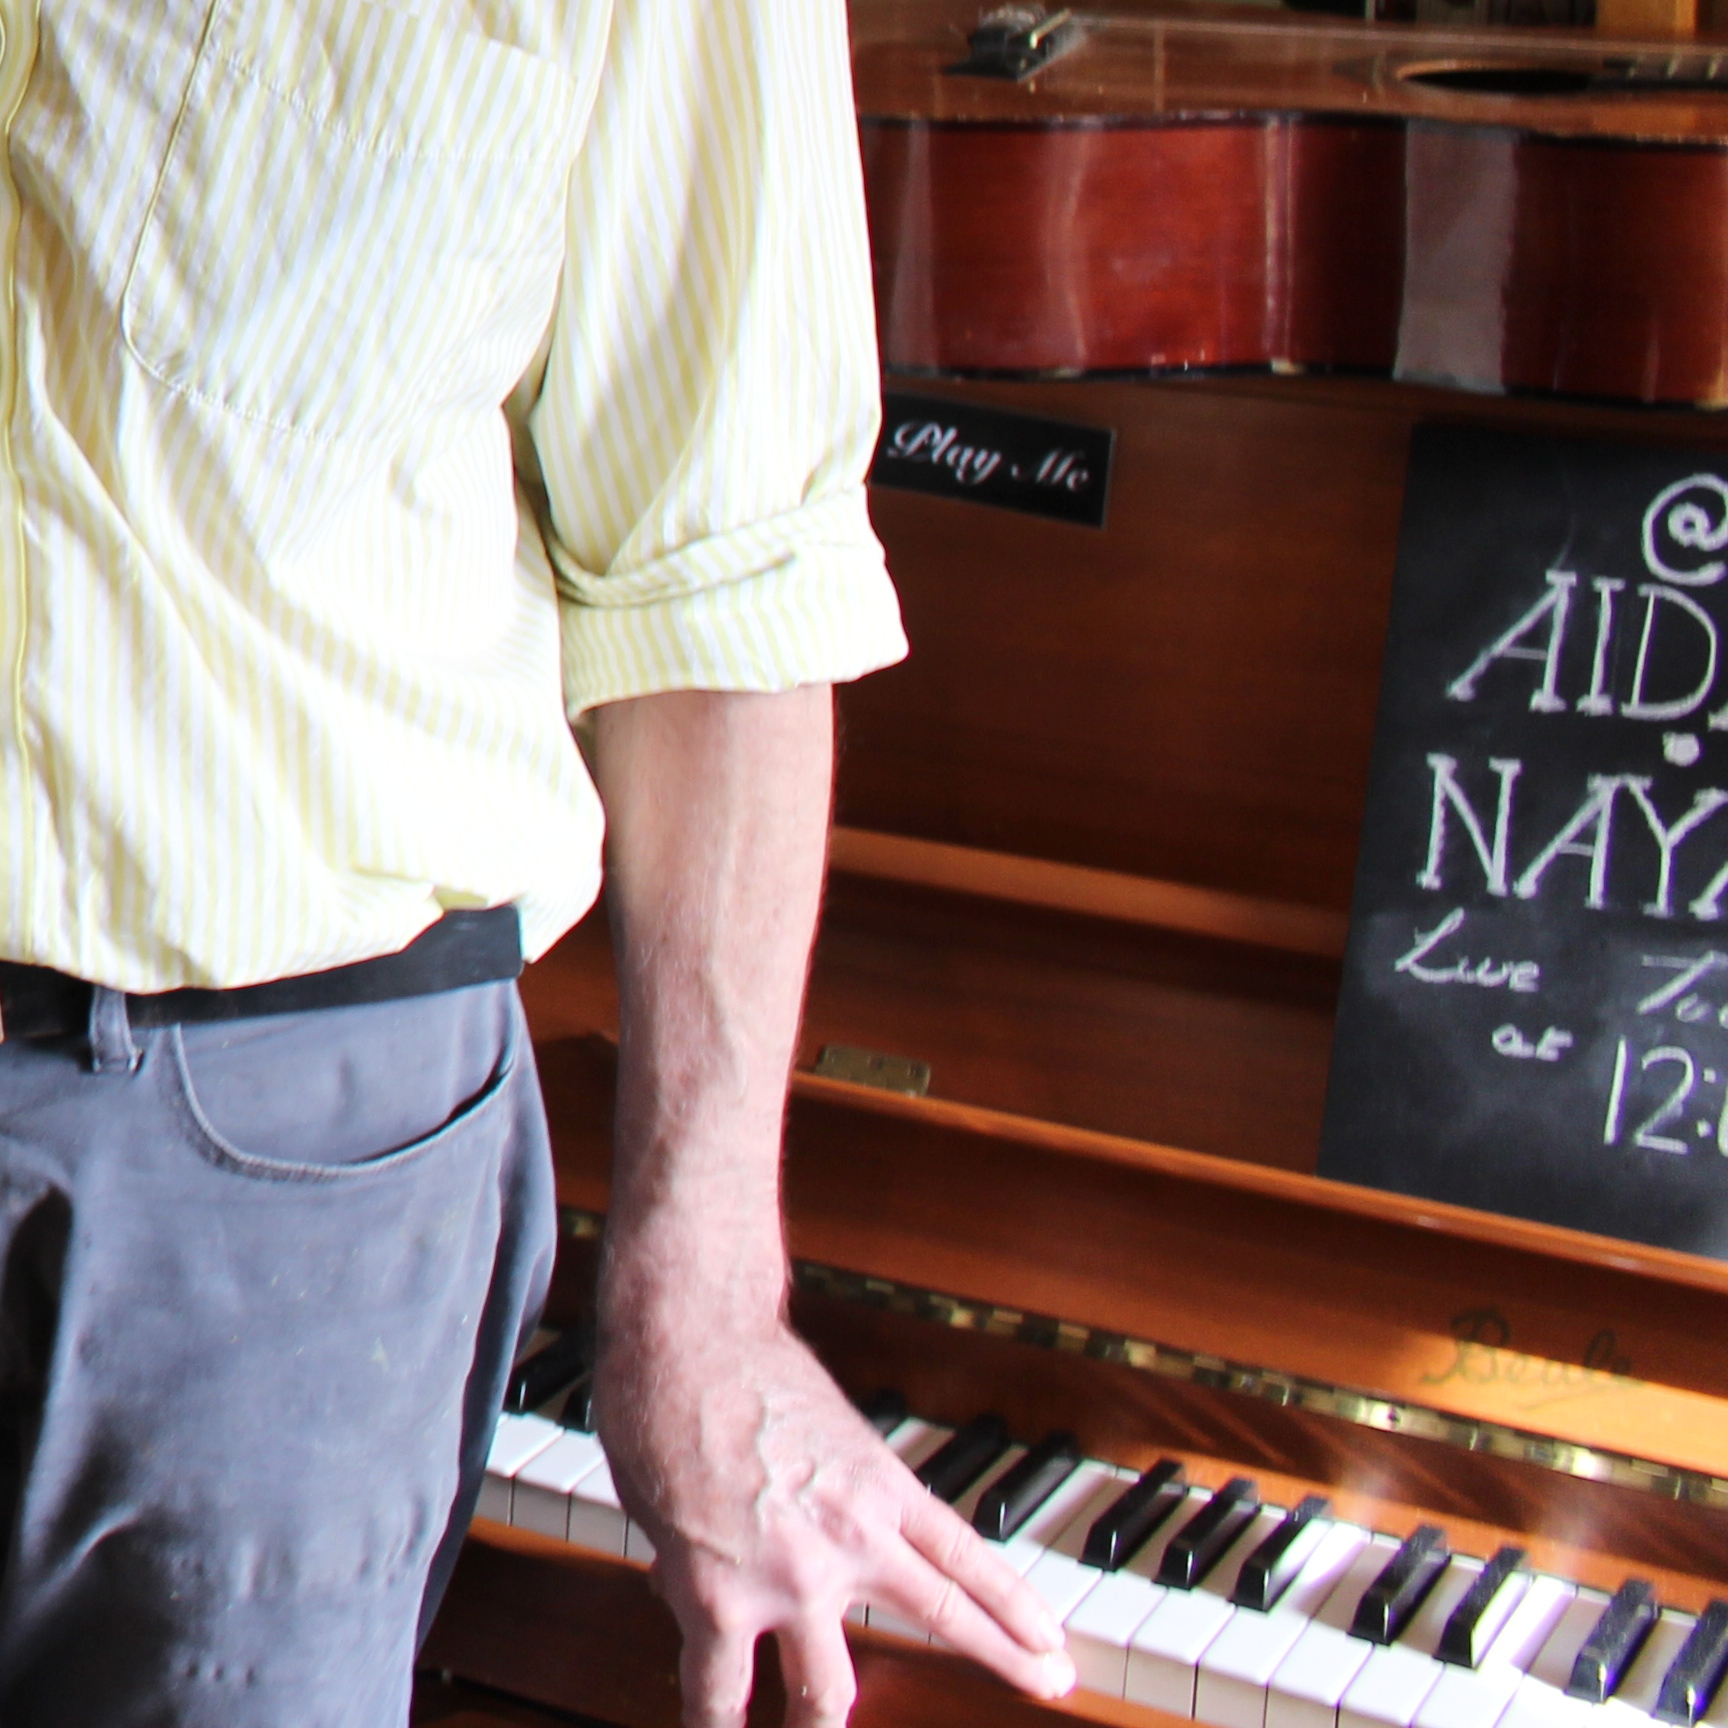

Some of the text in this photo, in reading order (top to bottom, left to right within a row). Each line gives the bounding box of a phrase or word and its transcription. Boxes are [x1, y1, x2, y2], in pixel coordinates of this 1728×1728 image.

[886, 421, 1089, 494] Play Me
[1445, 568, 1728, 733] AID
